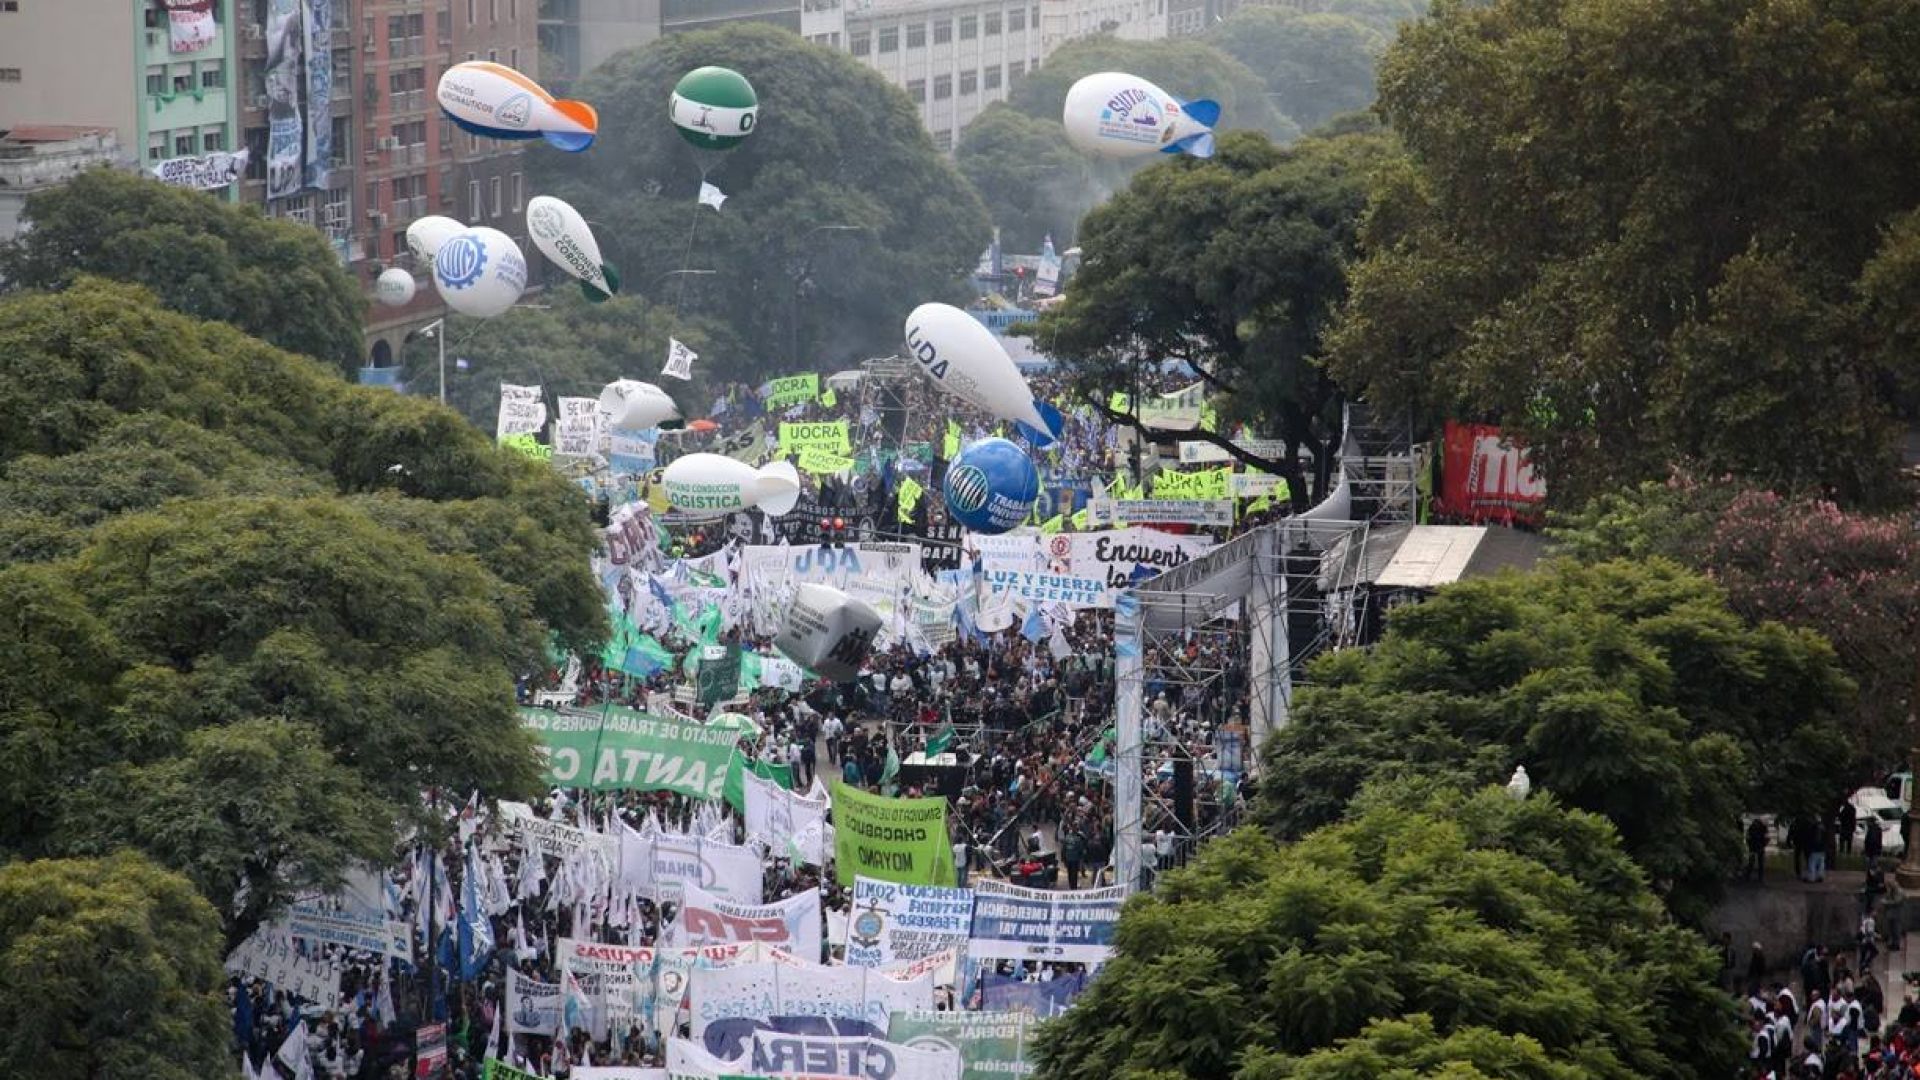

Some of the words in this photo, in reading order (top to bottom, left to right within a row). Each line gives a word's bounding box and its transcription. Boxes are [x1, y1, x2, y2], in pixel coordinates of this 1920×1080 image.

[907, 326, 949, 380] UDA
[790, 425, 841, 439] UOCRA
[983, 570, 1018, 584] LUZ
[1025, 573, 1033, 585] Y
[1039, 573, 1104, 593] FUERZA
[992, 582, 1096, 604] PESENTE
